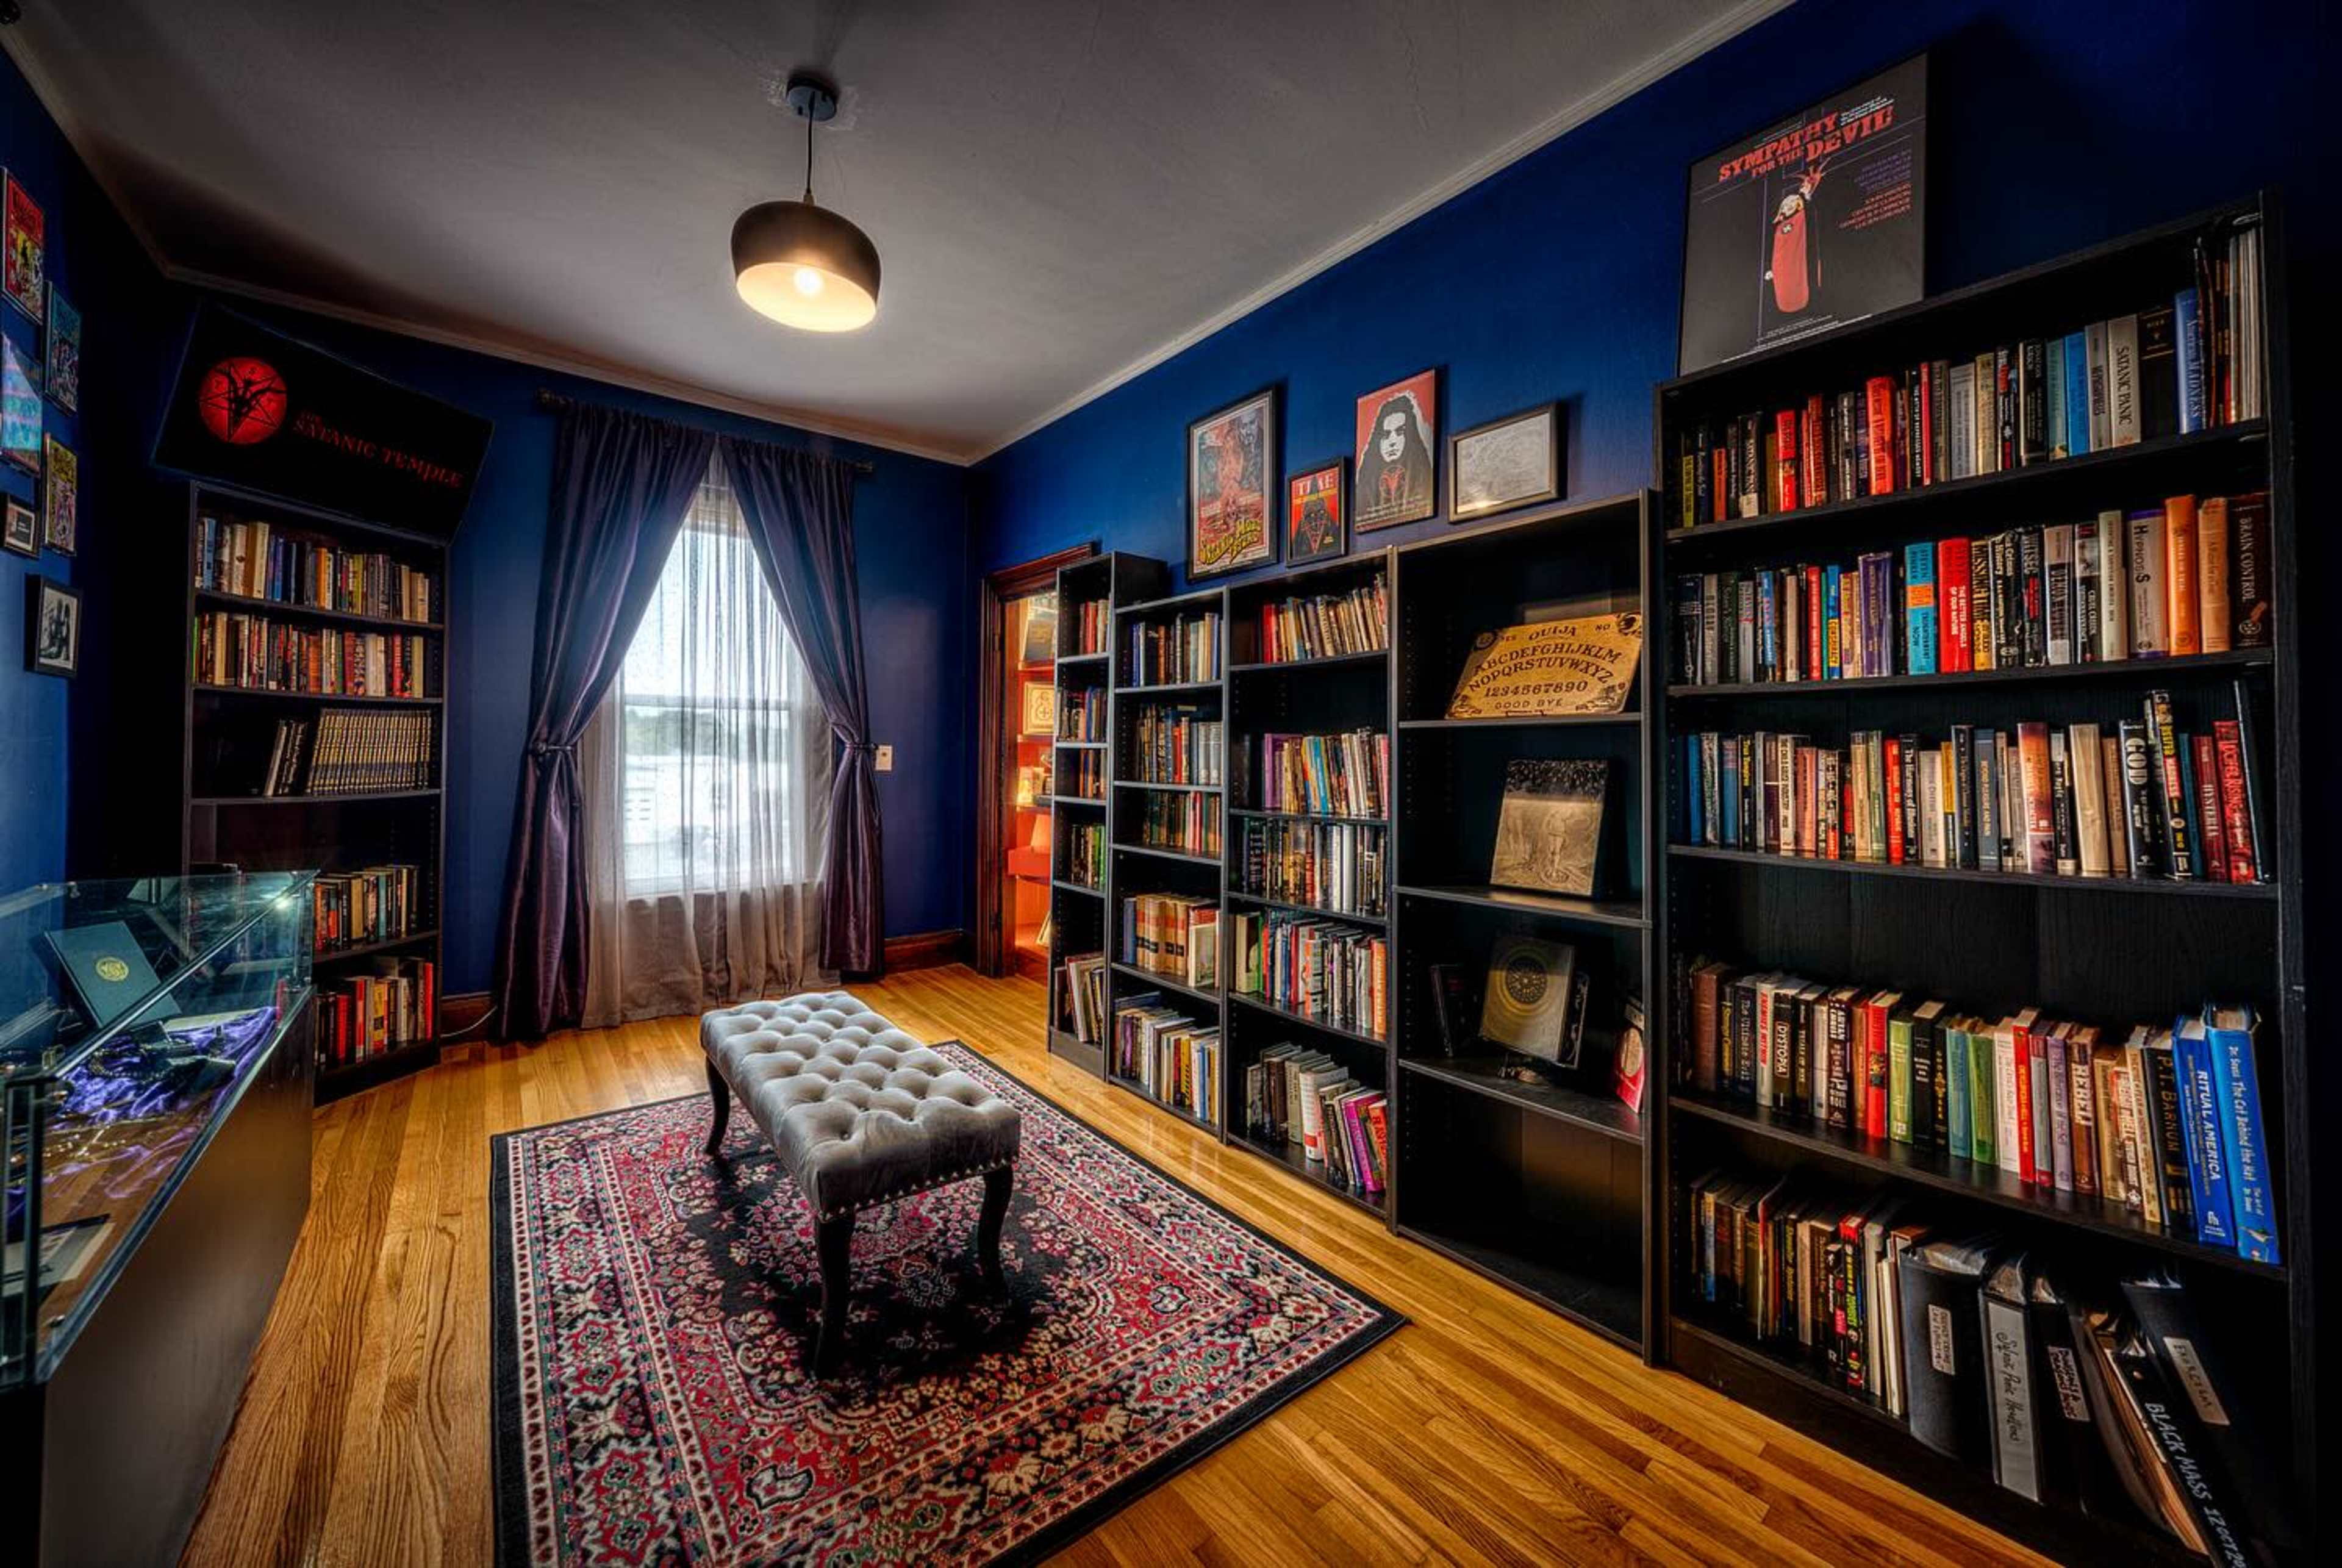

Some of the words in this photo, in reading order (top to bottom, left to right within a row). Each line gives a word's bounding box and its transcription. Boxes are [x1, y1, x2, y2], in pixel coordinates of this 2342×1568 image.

[1719, 112, 1839, 183] SYMPATHY
[1750, 162, 1775, 179] FOR
[2116, 346, 2130, 391] SATANIC
[2119, 393, 2132, 425] PANIC
[293, 419, 378, 459] SATANIC
[382, 447, 465, 488] TEMPLE
[2240, 517, 2254, 551] BRAIN
[1920, 549, 1930, 578] STEVEN
[2240, 553, 2255, 603] CONTROL
[1950, 585, 1957, 595] OF
[1528, 625, 1577, 642] OUIJA
[1595, 623, 1611, 632] NO
[1468, 656, 1614, 692] NOPQRSTUVWXYZ
[1472, 643, 1622, 675] ABCDEFGHIJKLM
[1483, 679, 1589, 698] 1234567890
[1904, 749, 1913, 763] The
[2125, 737, 2148, 785] GOD
[2203, 784, 2219, 838] HYSTERIA
[1741, 1000, 1750, 1015] The
[1741, 1017, 1750, 1056] Ultimate
[1775, 1025, 1788, 1073] DYSTOPIA
[2229, 1046, 2239, 1056] Dr.
[1741, 1059, 1750, 1081] Evil
[2158, 1056, 2174, 1087] P.T.
[2229, 1058, 2241, 1078] Seuss
[2197, 1070, 2215, 1118] RITUAL
[2231, 1081, 2246, 1097] The
[2161, 1090, 2181, 1153] BARNUM
[2233, 1099, 2248, 1115] Cat
[2235, 1117, 2254, 1146] Behind
[2204, 1121, 2221, 1181] AMERICA
[2240, 1148, 2254, 1162] the
[2243, 1165, 2256, 1181] Hat
[2144, 1403, 2187, 1453] BLACK
[2175, 1455, 2213, 1500] MASS
